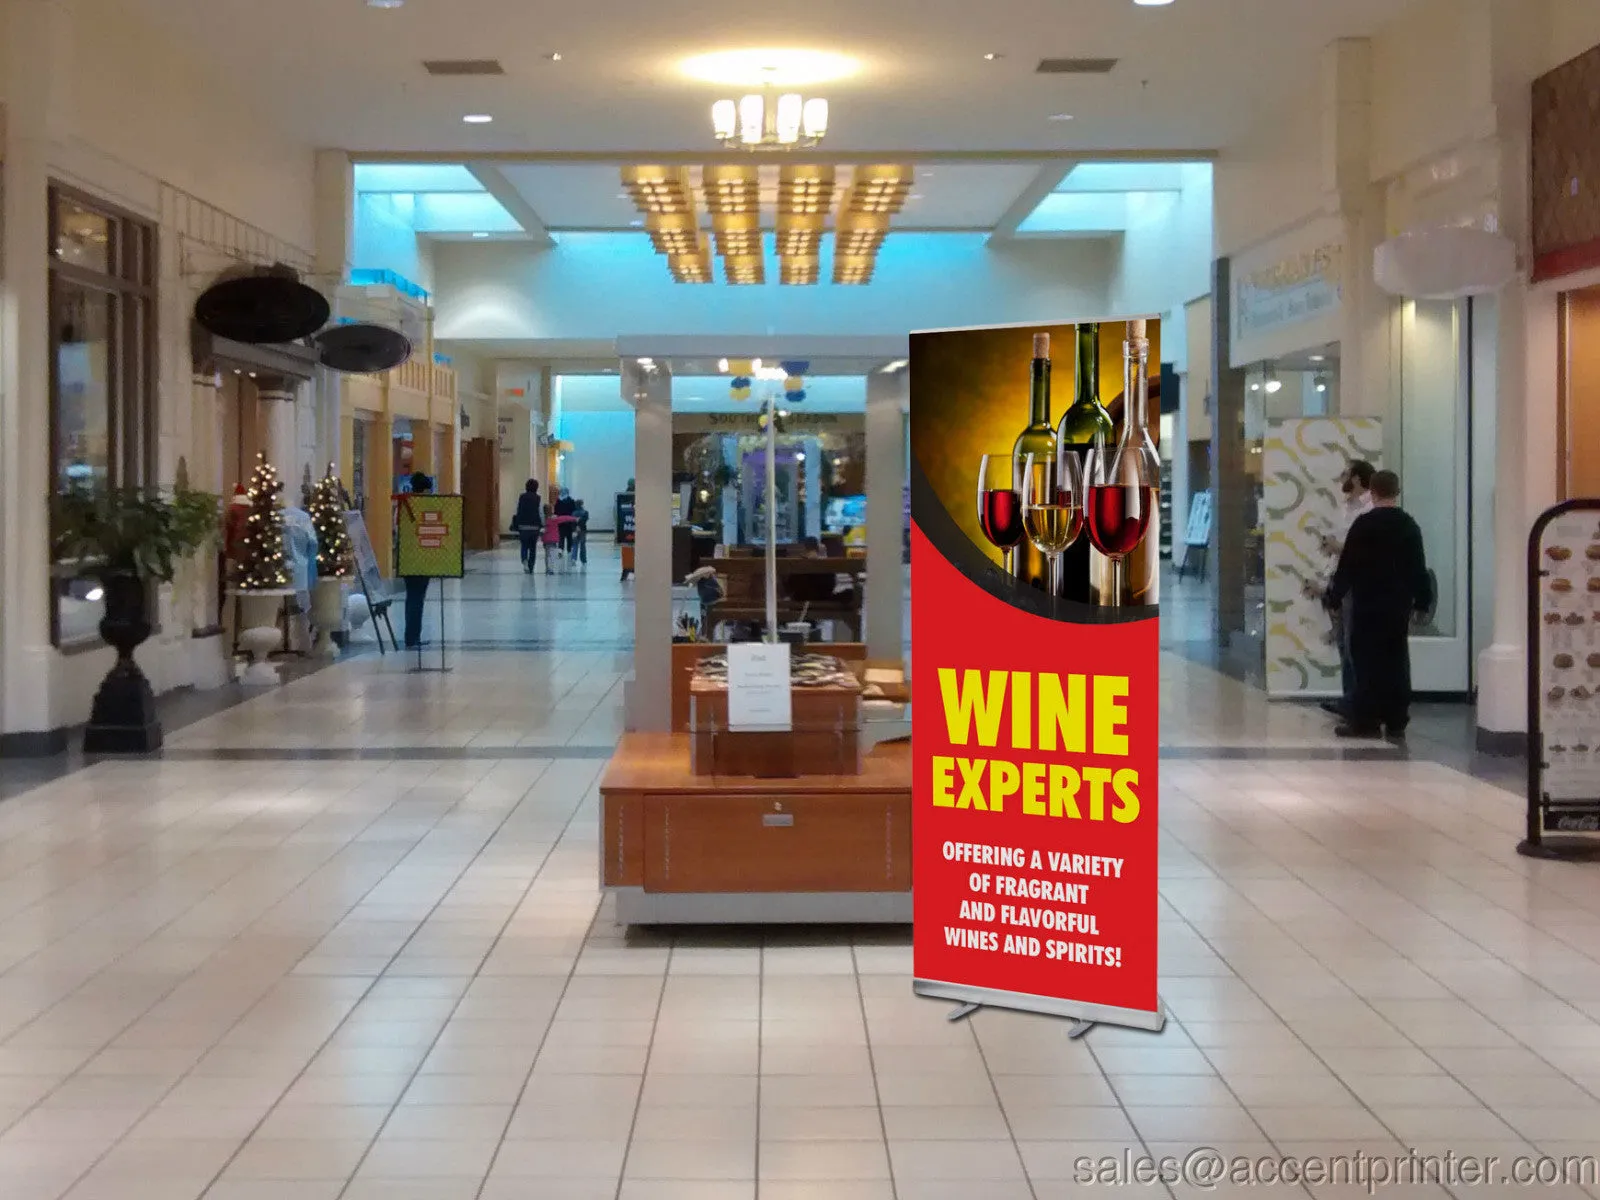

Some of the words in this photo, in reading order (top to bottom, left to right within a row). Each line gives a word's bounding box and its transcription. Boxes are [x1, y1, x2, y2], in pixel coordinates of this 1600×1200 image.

[937, 667, 1129, 756] WINE
[932, 755, 1140, 823] EXPERTS
[942, 840, 1025, 868] OFFERING
[1029, 850, 1043, 870] A
[1047, 851, 1124, 879] VARIETY
[969, 872, 991, 893] OF
[995, 875, 1090, 905] FRAGRANT
[959, 899, 996, 922] AND
[1001, 904, 1100, 935] FLAVORFUL
[943, 926, 999, 952] WINES
[1003, 934, 1041, 957] AND
[1045, 939, 1122, 968] SPIRITS!
